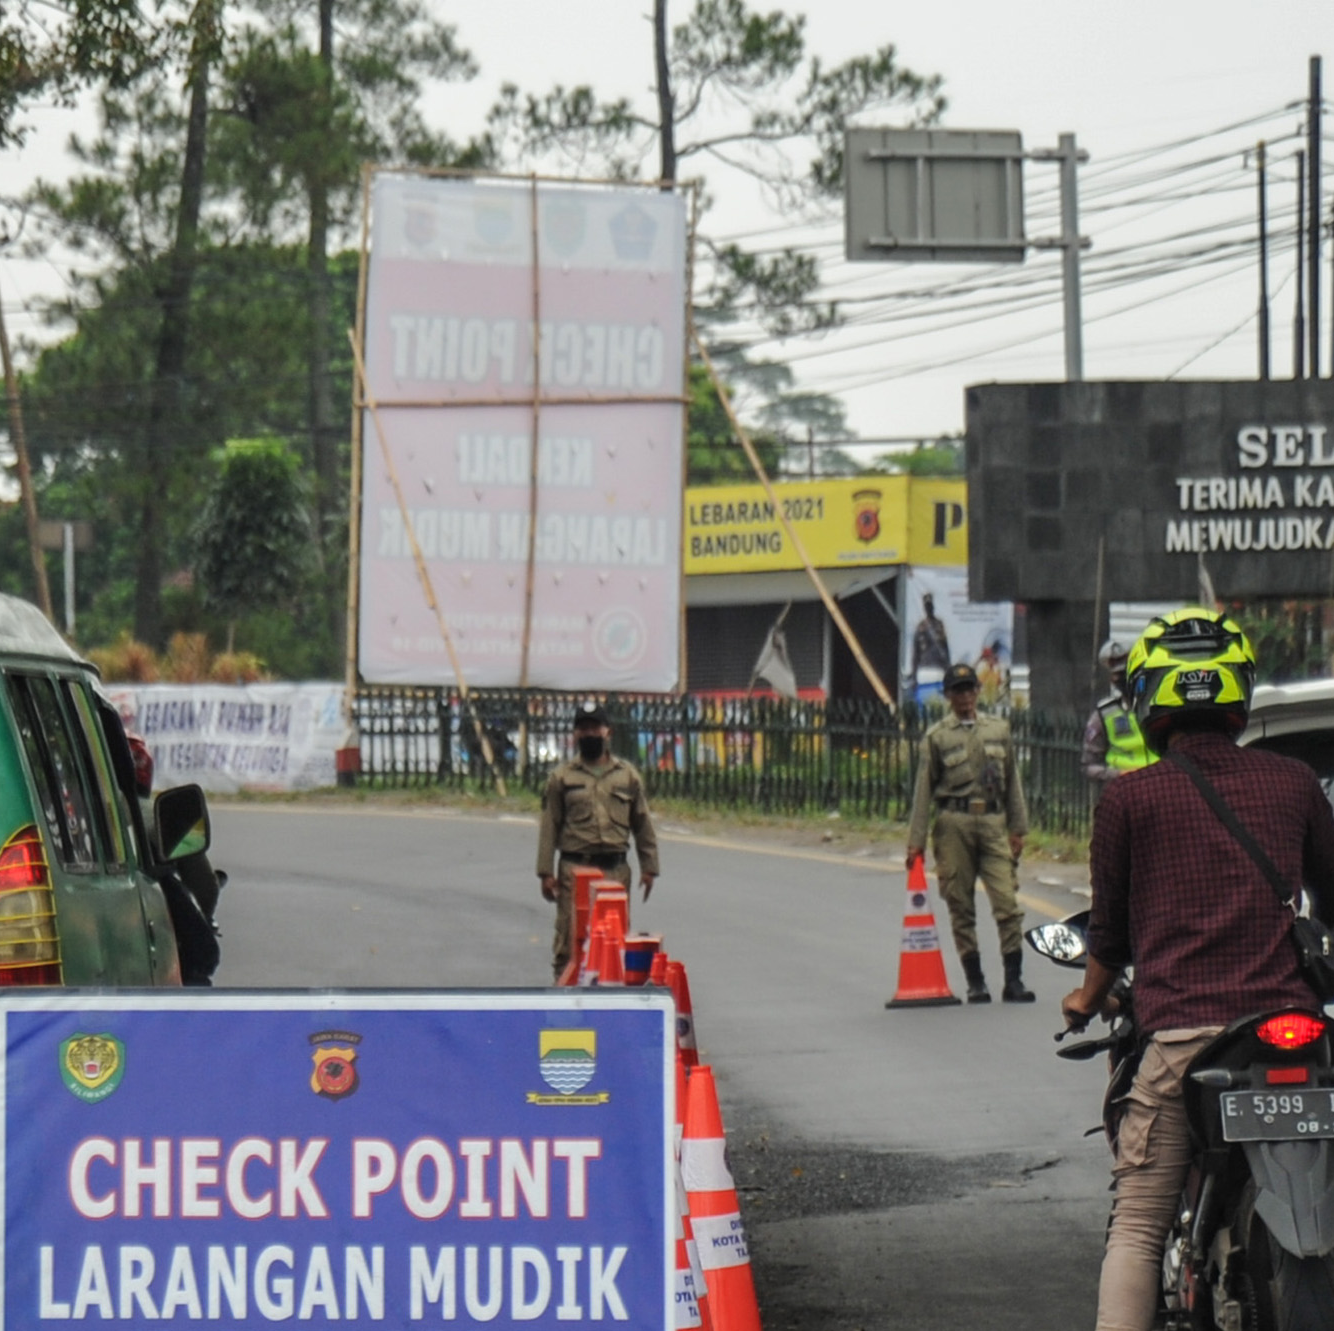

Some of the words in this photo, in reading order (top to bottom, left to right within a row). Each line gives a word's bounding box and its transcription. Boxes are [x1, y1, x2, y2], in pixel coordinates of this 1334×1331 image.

[1176, 475, 1284, 511] TERIMA
[690, 502, 775, 526] LEBARAN
[784, 497, 825, 521] 2021
[691, 531, 782, 557] BANDUNG
[1253, 1095, 1303, 1114] 5399
[69, 1136, 329, 1220] CHECK
[352, 1136, 602, 1220] POINT
[39, 1244, 385, 1320] LARANGAN
[410, 1244, 630, 1321] MUDIK
